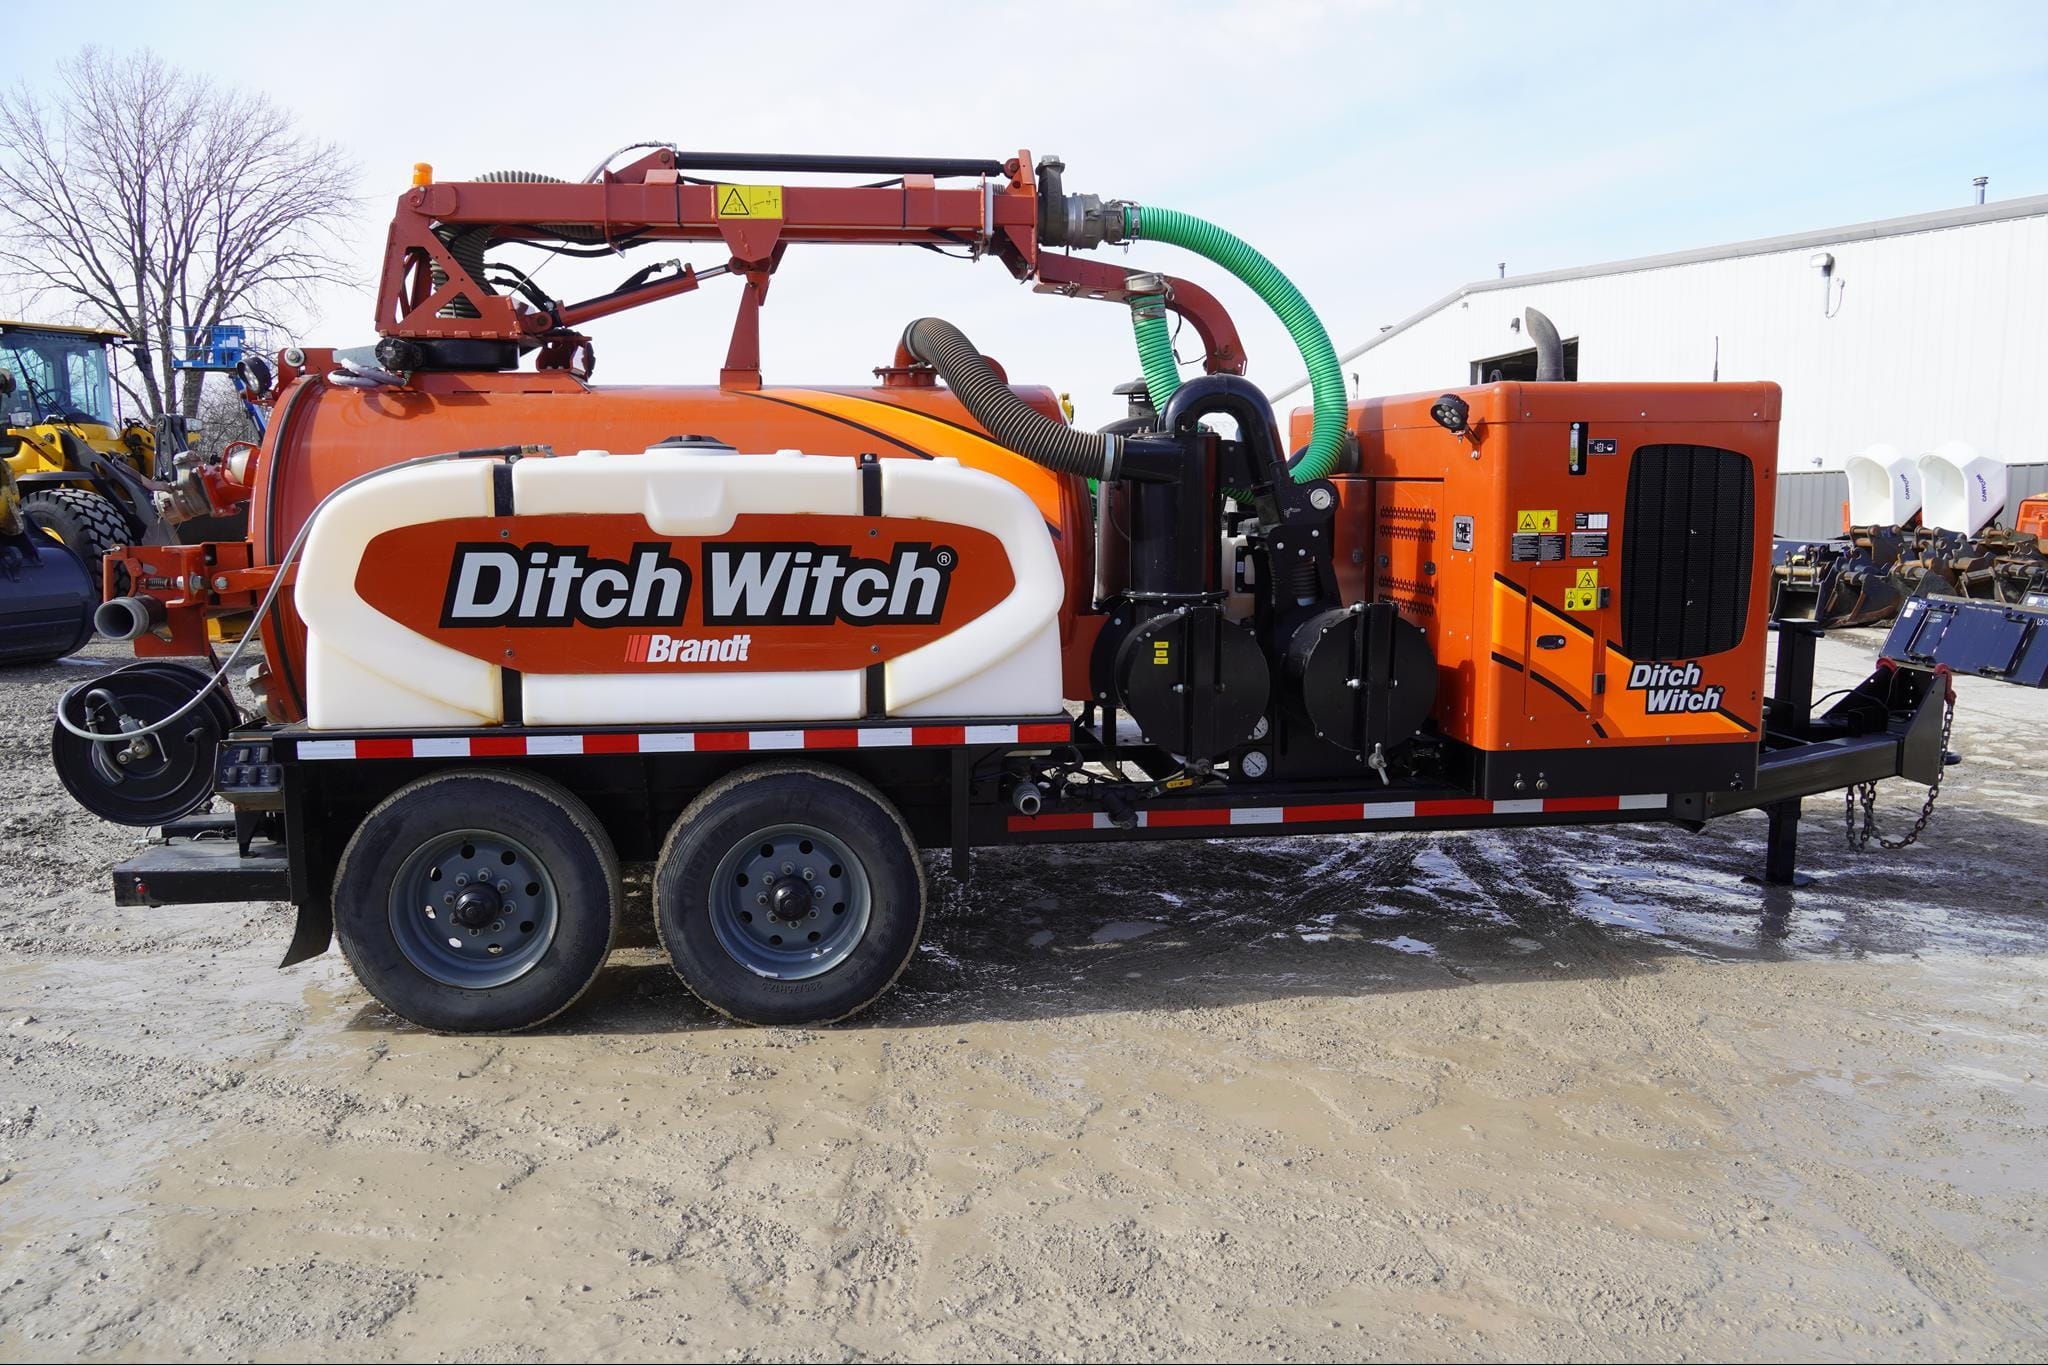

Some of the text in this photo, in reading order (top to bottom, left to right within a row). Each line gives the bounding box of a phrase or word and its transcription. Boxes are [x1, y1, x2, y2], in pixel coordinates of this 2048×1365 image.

[451, 551, 683, 619] Ditch
[646, 634, 752, 663] Brandt
[1629, 662, 1701, 688] Ditch
